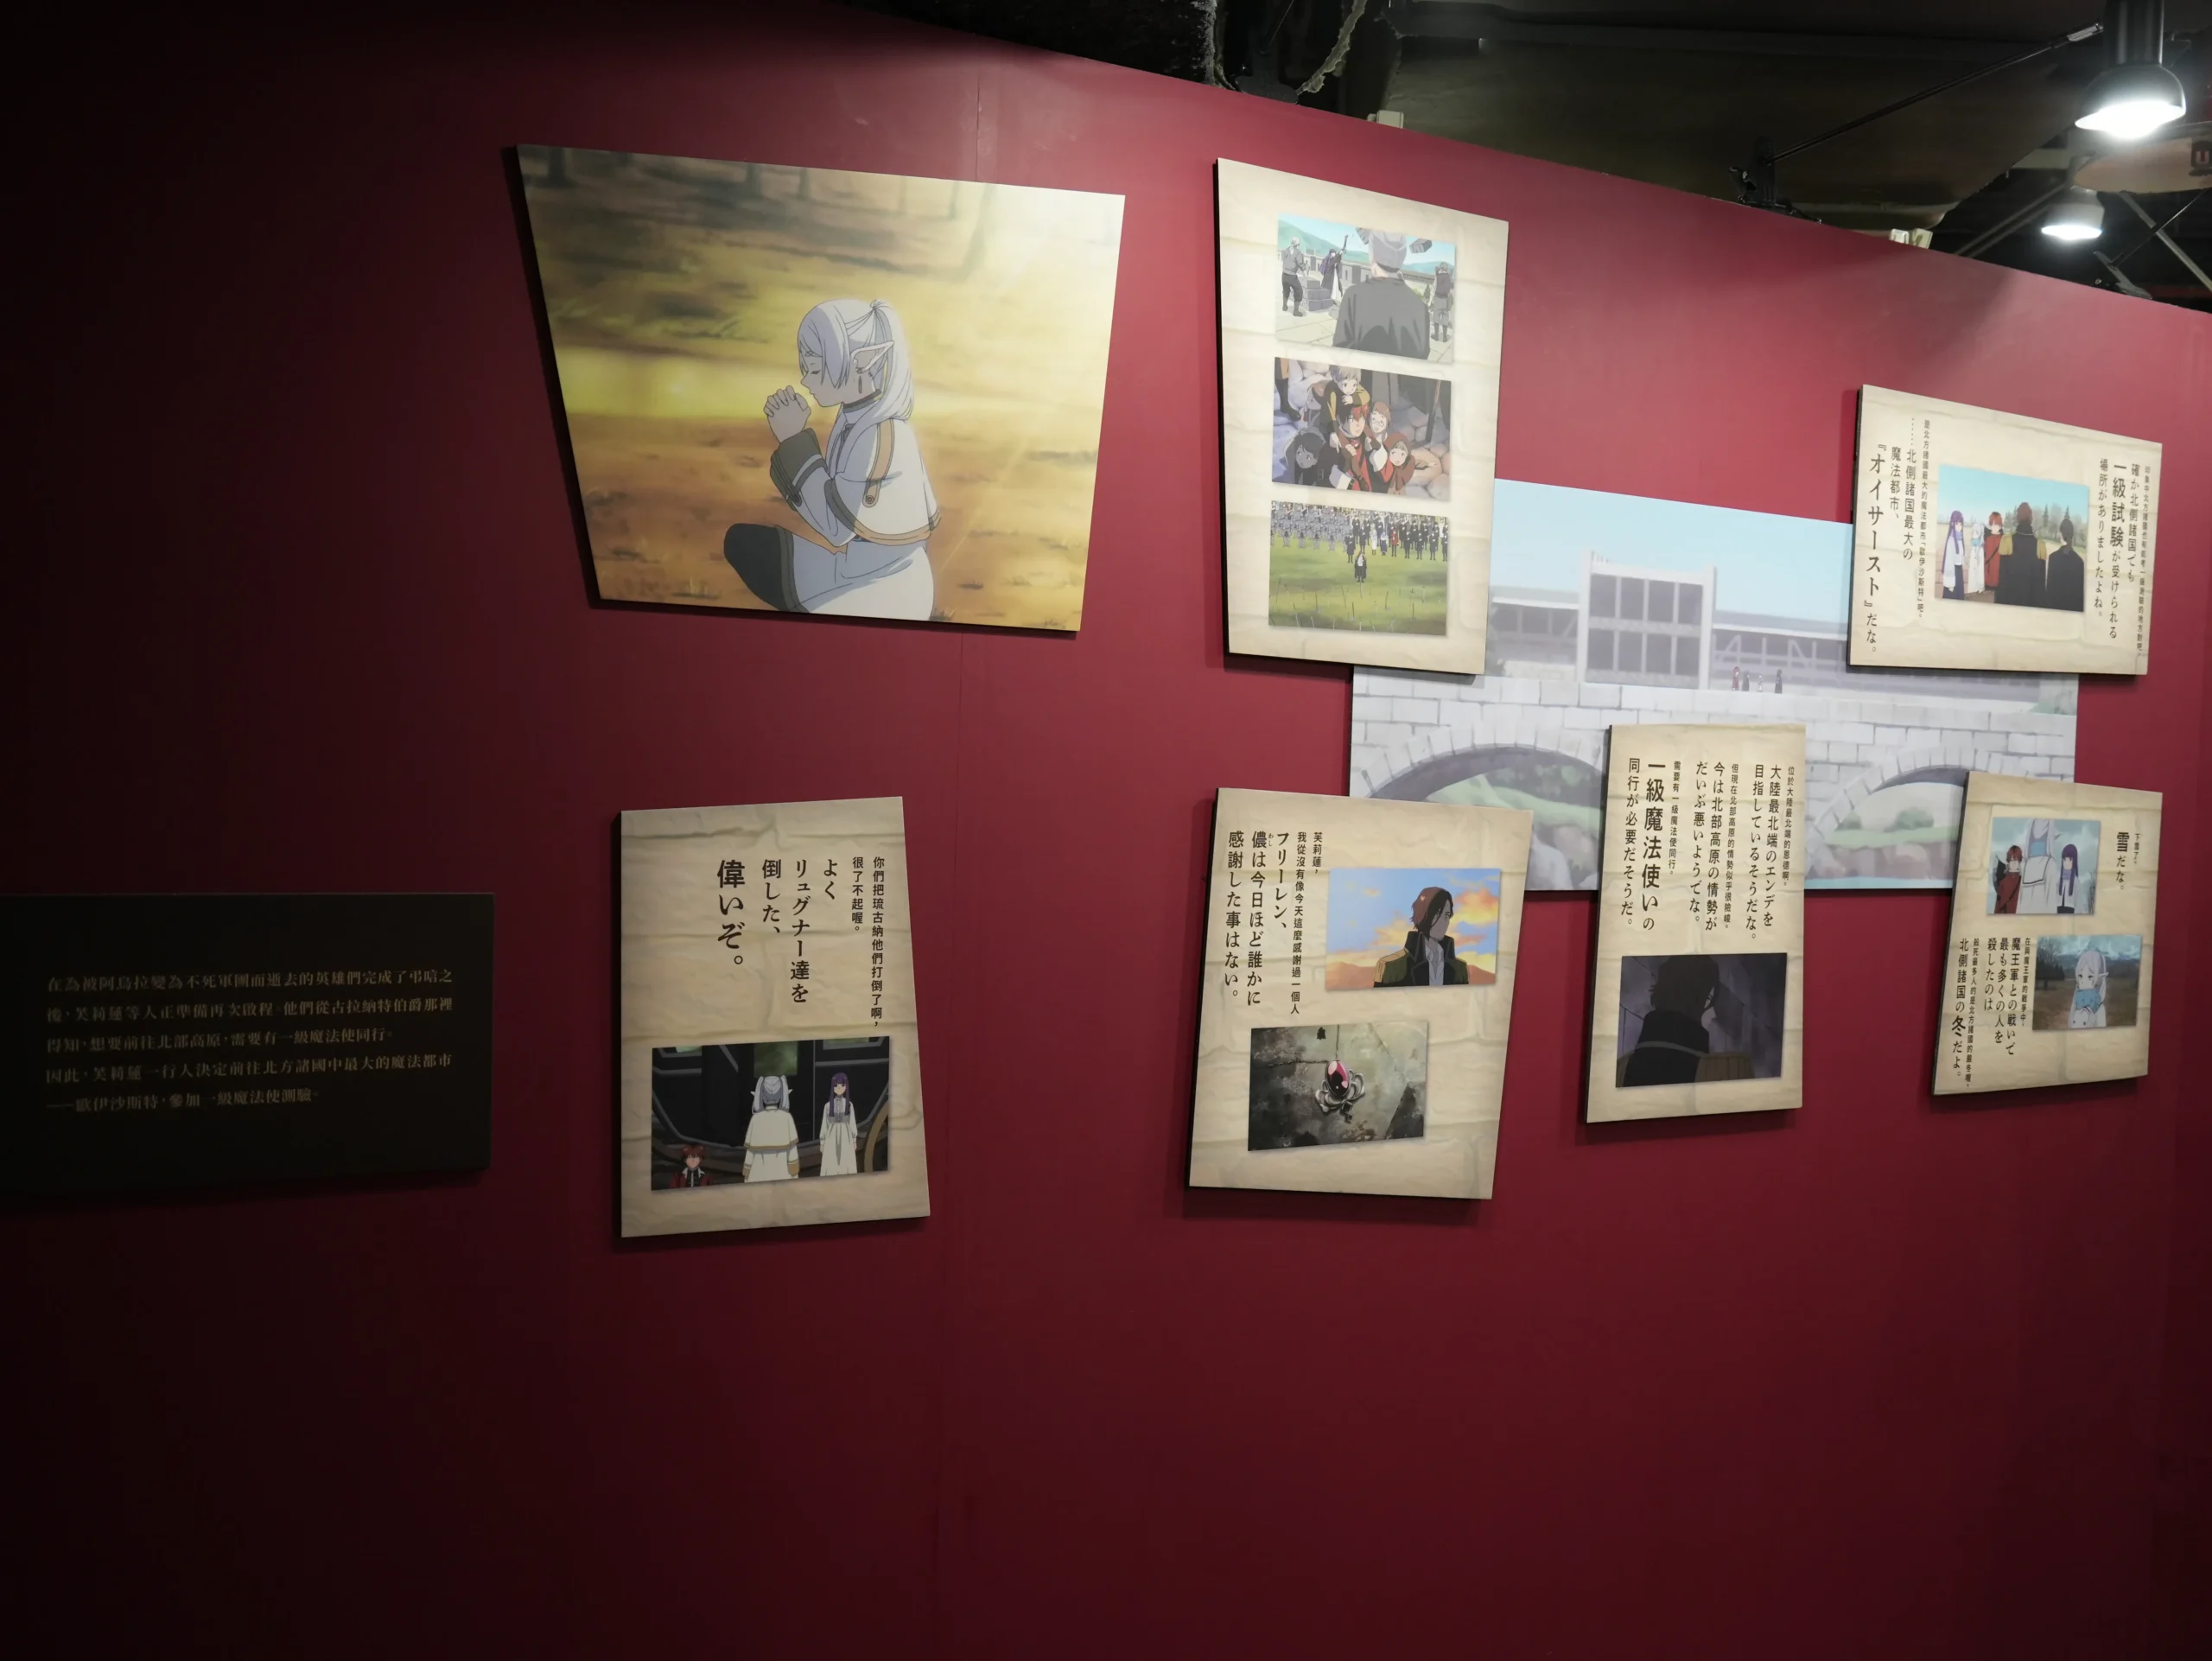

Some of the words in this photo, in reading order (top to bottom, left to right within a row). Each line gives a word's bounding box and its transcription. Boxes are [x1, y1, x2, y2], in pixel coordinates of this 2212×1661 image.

[1864, 443, 1887, 652] 『オイサースト』だな。
[1889, 446, 1902, 519] 魔法都市、
[2094, 458, 2108, 617] 場所がありましたよね。
[2109, 462, 2126, 639] 一級試験が受けられる
[2126, 463, 2139, 582] 確か北側諸国でも
[823, 858, 837, 900] よく
[1274, 832, 1290, 928] フリーレン、
[1312, 832, 1323, 874] 芙莉蓮，
[1621, 758, 1640, 925] 同行が必要だそうだ。
[1642, 763, 1666, 930] 一級魔法使いの
[1669, 760, 1681, 875] 需要有一級魔法使同行。
[1689, 761, 1708, 922] だいぶ悪いようでな。
[1705, 761, 1726, 931] 今は北部高原の情勢が
[1724, 764, 1738, 928] 但現在北部高原的情勢似乎很險峻。
[1745, 764, 1764, 939] 目指しているそうだな。
[1764, 765, 1782, 927] 大陸最北端のエンデを
[1782, 766, 1795, 886] 位於大陸最北端的恩德啊。
[2116, 831, 2130, 890] 雪だな。
[716, 859, 746, 965] 偉いぞ。
[762, 859, 781, 933] 倒した、
[791, 859, 810, 1002] リュグナー達を
[851, 856, 863, 932] 很了不起喔。
[871, 856, 885, 1027] 你們把琉古納他們打倒了啊，
[1224, 830, 1244, 996] 感謝した事はない。
[1247, 830, 1268, 1006] 儂は今日ほど誰かに
[1290, 832, 1307, 1015] 我從沒有像今天這麼感謝過一個人
[1951, 938, 1969, 1077] 北側諸国の冬だよ。
[1984, 938, 1997, 1010] 殺したのは
[1994, 938, 2009, 1044] 最も多くの人を
[2005, 938, 2021, 1055] 魔王軍との戦いで
